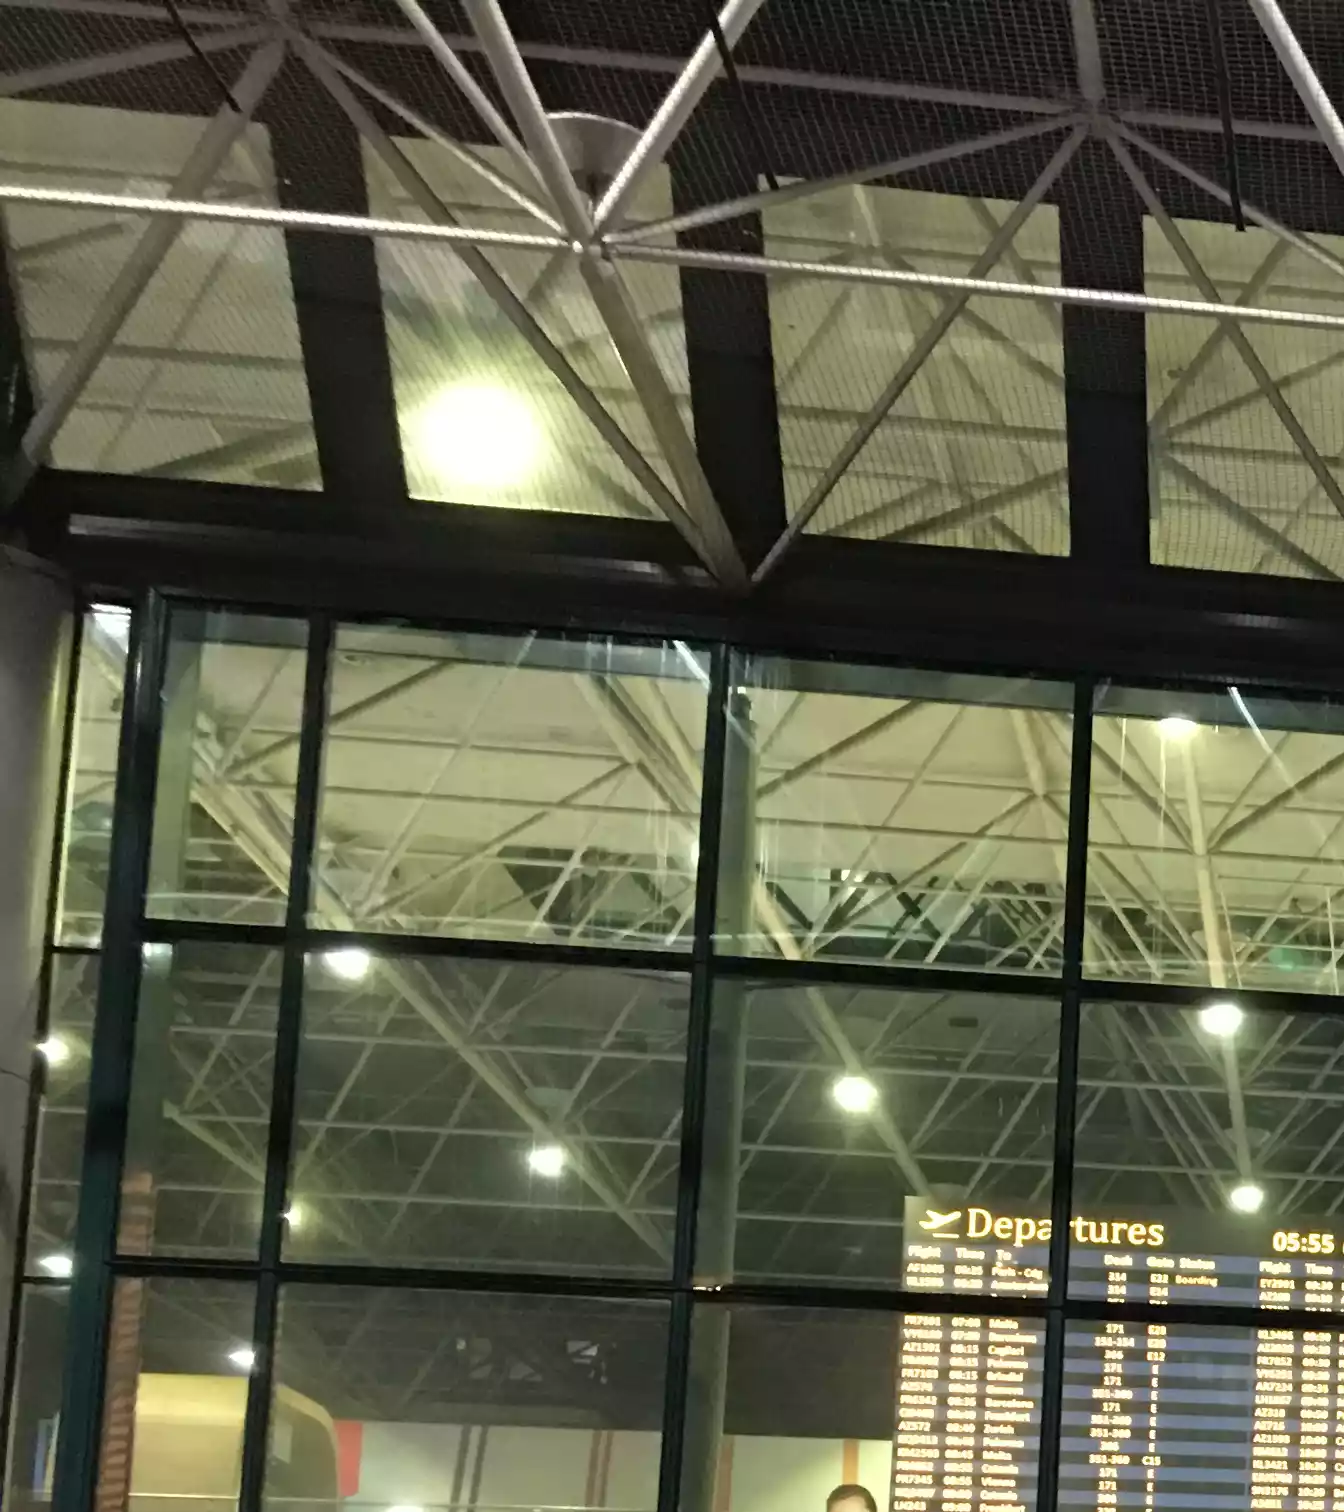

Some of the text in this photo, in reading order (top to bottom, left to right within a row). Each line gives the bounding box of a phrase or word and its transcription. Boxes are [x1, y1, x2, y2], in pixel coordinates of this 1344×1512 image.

[967, 1207, 1164, 1247] Depatures
[1273, 1232, 1334, 1253] 05:55
[908, 1244, 942, 1260] Flight
[955, 1247, 985, 1260] Time
[995, 1249, 1012, 1260] To
[1259, 1261, 1291, 1275] Flight
[1305, 1263, 1333, 1275] Time
[1176, 1275, 1217, 1287] Boarding
[1106, 1324, 1124, 1334] 171
[1104, 1376, 1121, 1386] 171
[1103, 1402, 1120, 1412] 171
[1099, 1481, 1116, 1490] 171
